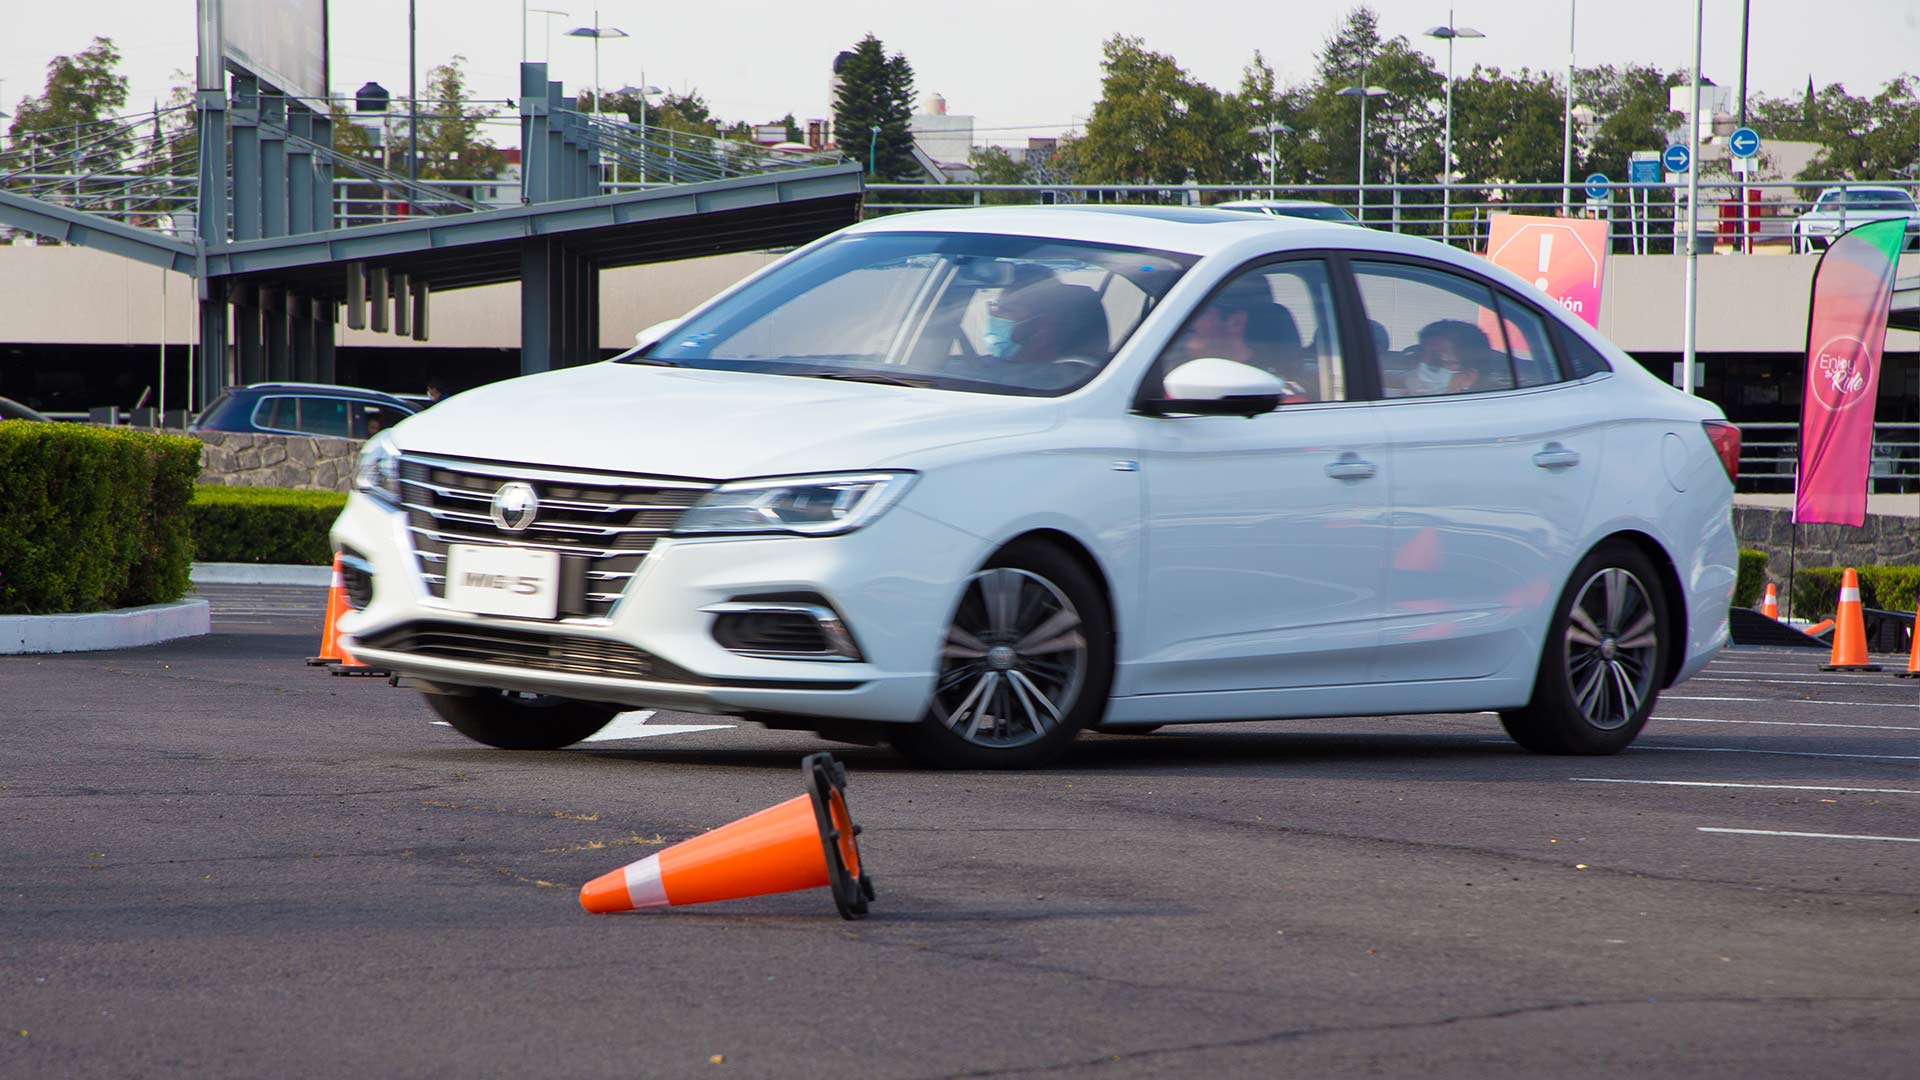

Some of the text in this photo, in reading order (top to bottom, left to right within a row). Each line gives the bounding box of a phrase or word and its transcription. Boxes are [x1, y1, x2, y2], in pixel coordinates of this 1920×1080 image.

[1554, 296, 1583, 313] ión
[1820, 354, 1856, 374] Enjoy
[1832, 370, 1863, 393] Ride
